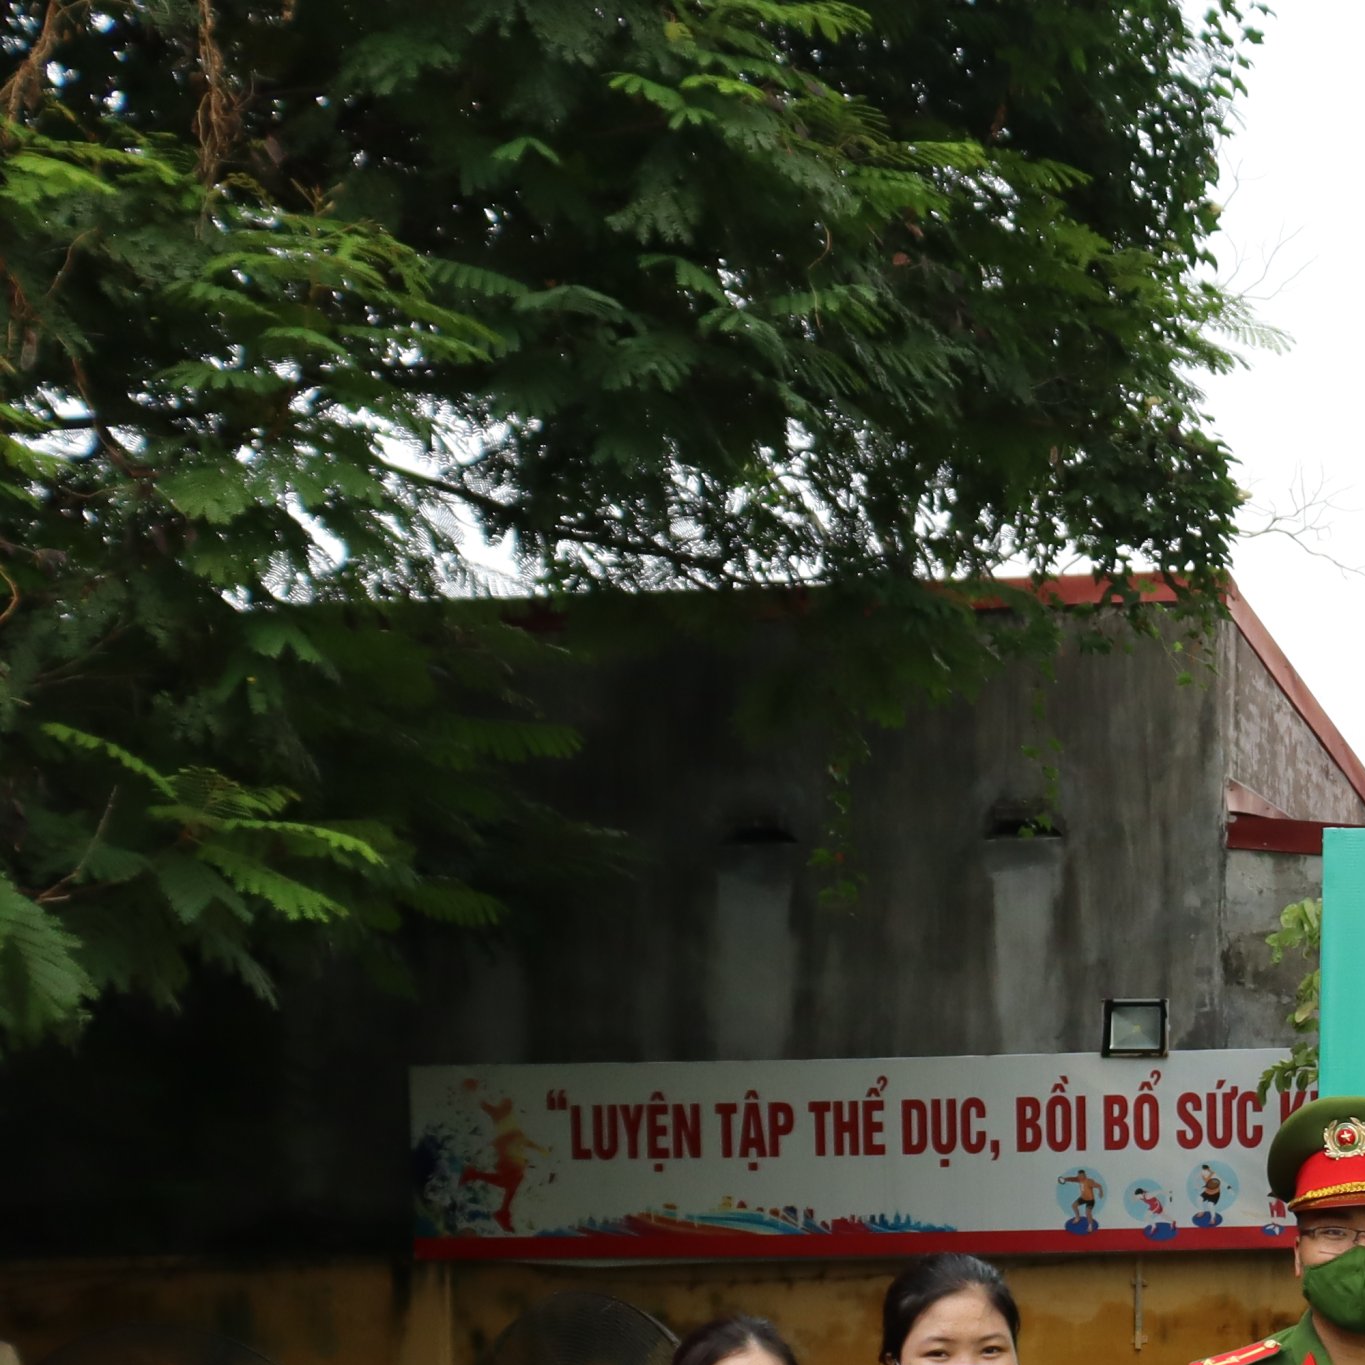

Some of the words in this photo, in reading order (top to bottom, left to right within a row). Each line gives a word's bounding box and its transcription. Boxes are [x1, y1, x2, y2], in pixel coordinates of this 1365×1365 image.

[714, 1088, 795, 1172] TẬP
[808, 1074, 888, 1158] THỂ
[901, 1097, 1001, 1168] DỤC,
[1015, 1074, 1087, 1153] BỒI
[1103, 1069, 1162, 1152] BỔ
[1175, 1079, 1264, 1151] SỨC
